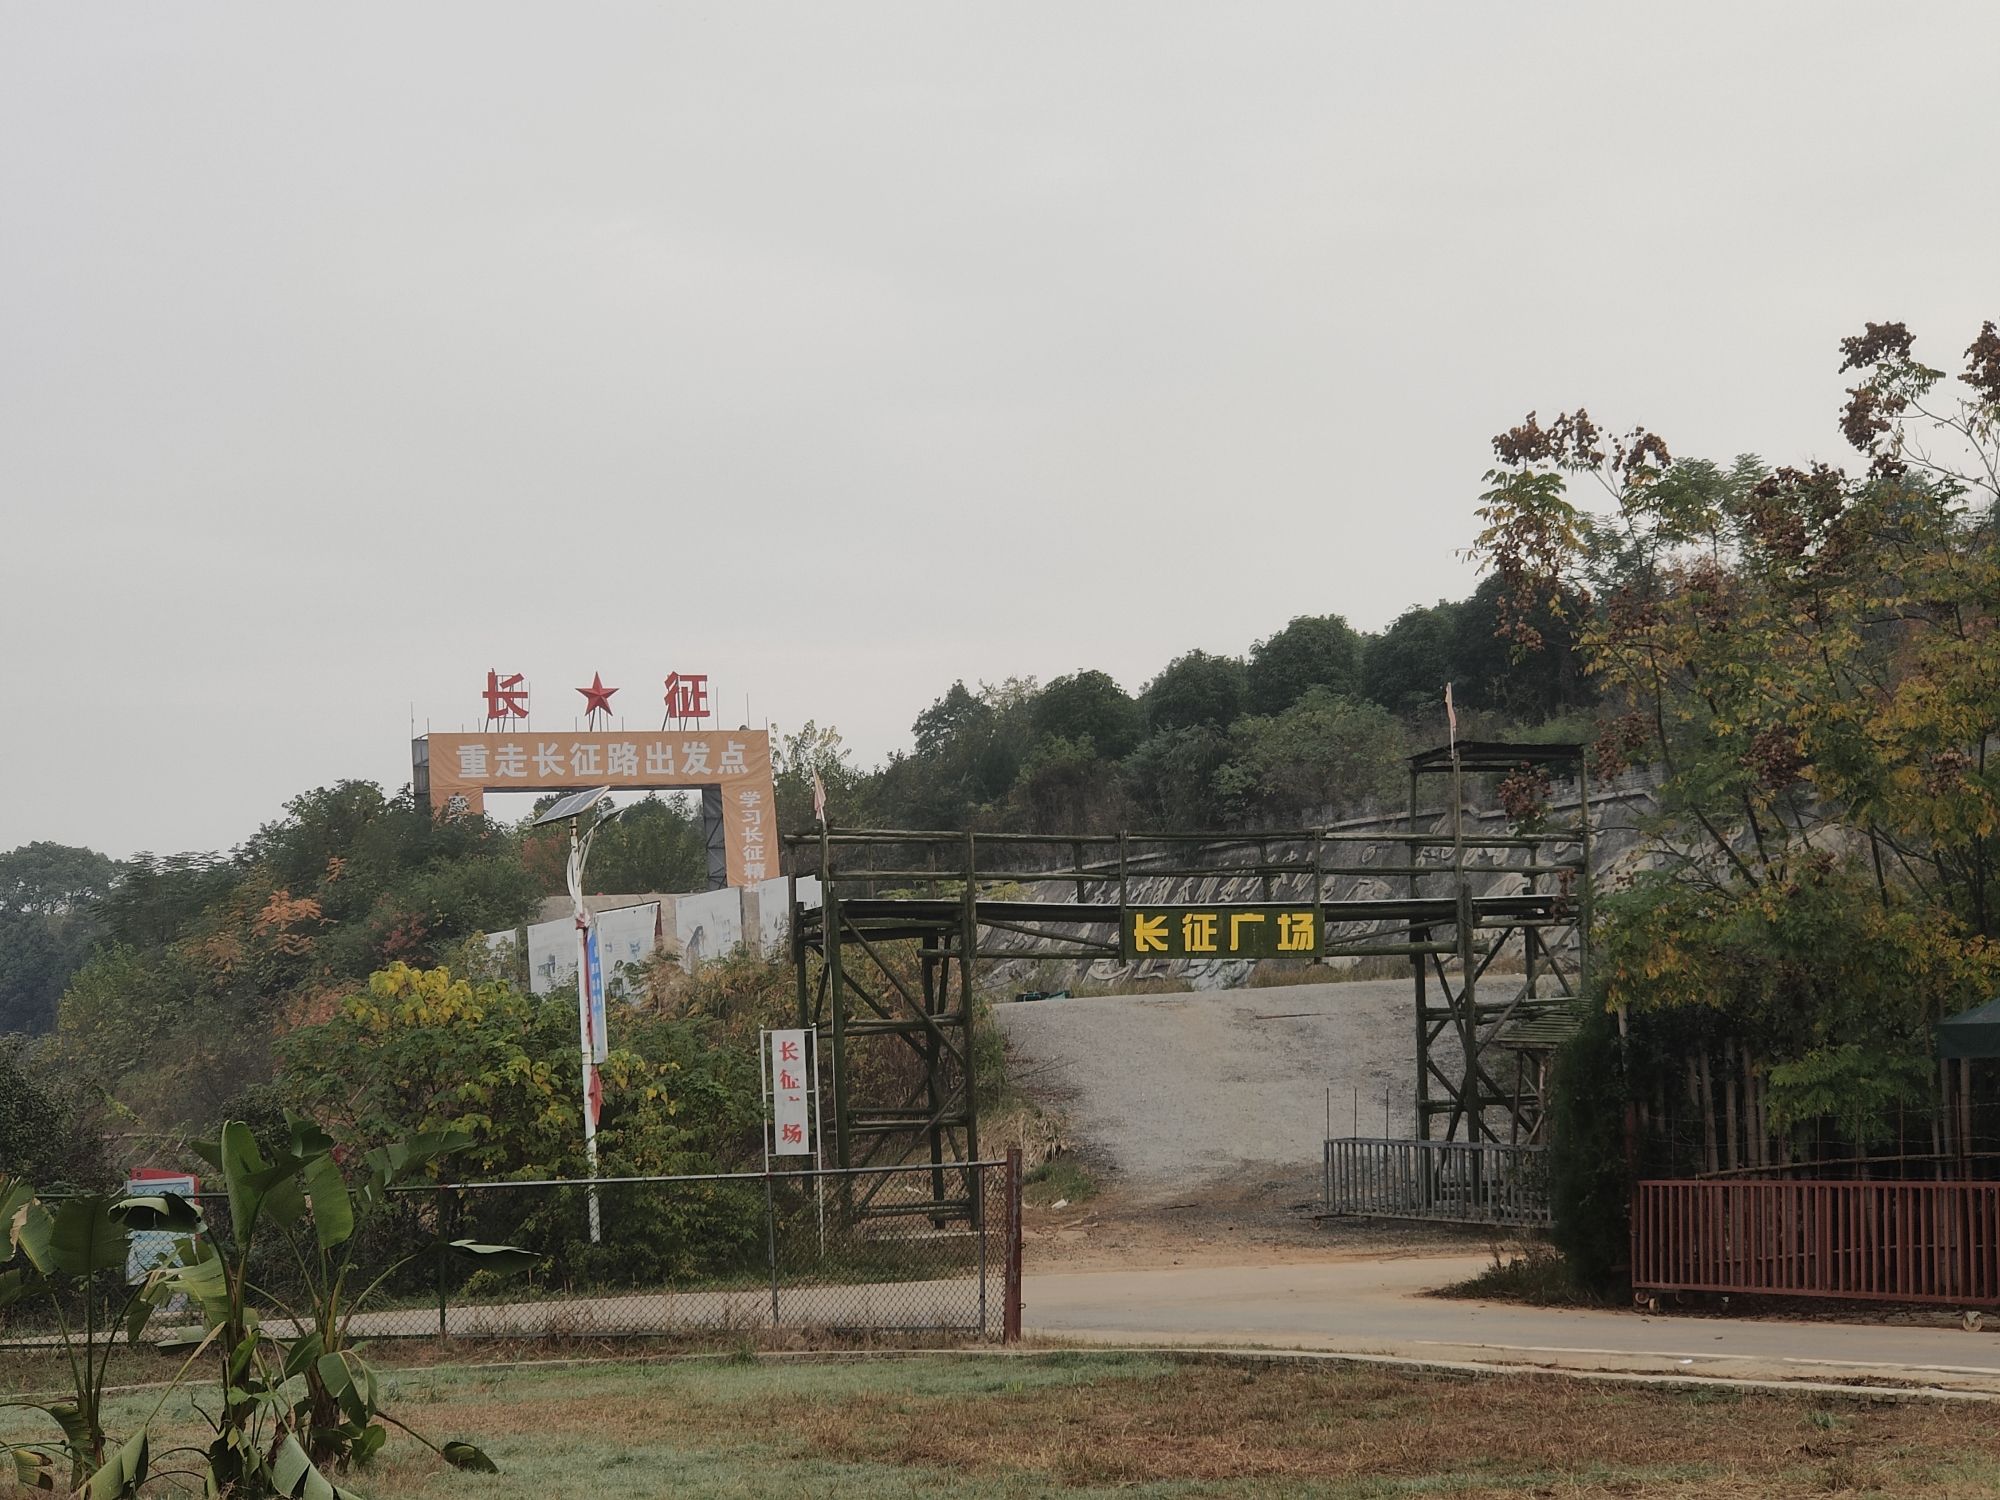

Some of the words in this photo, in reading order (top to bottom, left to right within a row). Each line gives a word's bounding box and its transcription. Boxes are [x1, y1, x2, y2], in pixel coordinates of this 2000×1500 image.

[456, 741, 749, 778] 重走长征路出发点
[1134, 913, 1314, 952] 长征广场
[779, 1041, 802, 1144] 长征场
